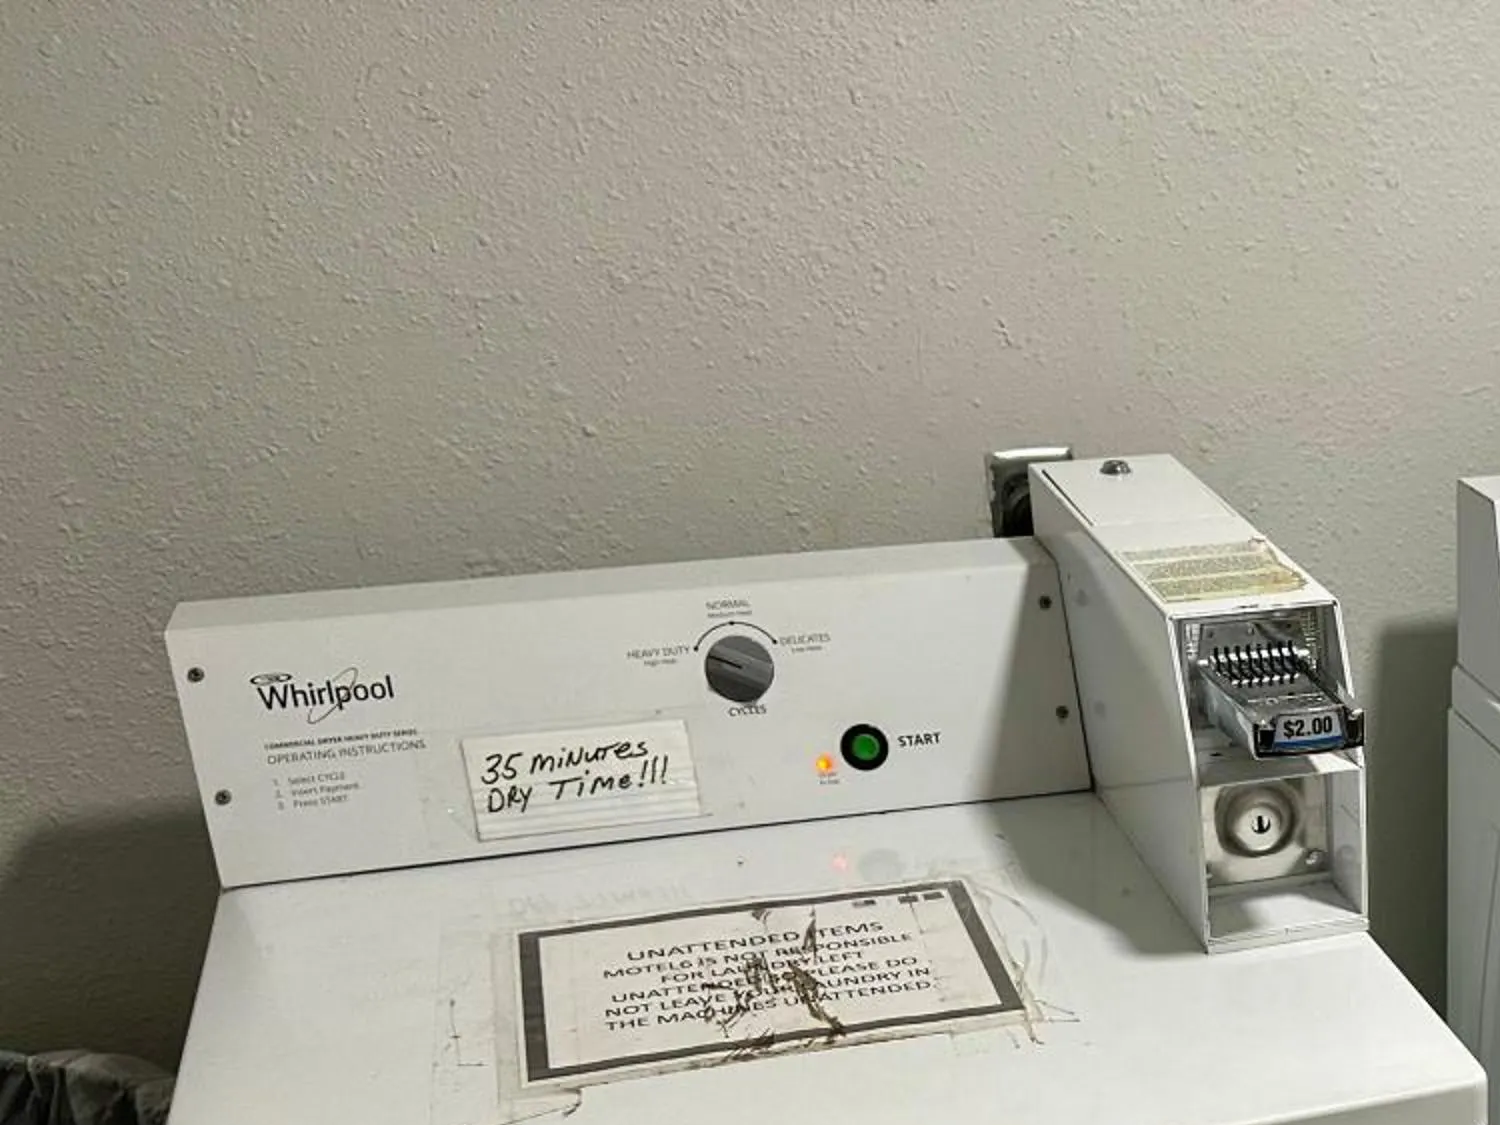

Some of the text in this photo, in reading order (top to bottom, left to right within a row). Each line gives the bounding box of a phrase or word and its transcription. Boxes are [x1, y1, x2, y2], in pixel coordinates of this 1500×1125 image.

[627, 646, 690, 660] HEAVY DUTY
[779, 633, 832, 646] DELICATES
[256, 673, 396, 712] Whirlpool
[728, 704, 768, 718] CYCLES
[897, 732, 941, 748] START
[1283, 715, 1333, 739] $2.00
[267, 738, 427, 766] OPERATING INSTRUCTIONS
[481, 752, 524, 784] 35
[487, 785, 533, 813] DRY
[628, 922, 884, 961] UNATTENDED TEMS
[723, 951, 767, 965] NOT
[775, 932, 913, 957] REPONSIBLE
[661, 972, 704, 984] FOR
[819, 951, 863, 963] LEFT
[886, 956, 918, 968] DO
[605, 1003, 651, 1017] NOT
[660, 993, 726, 1011] LEAVE
[804, 971, 902, 990] AUNDRY
[907, 967, 930, 977] IN
[605, 1017, 651, 1031] THE
